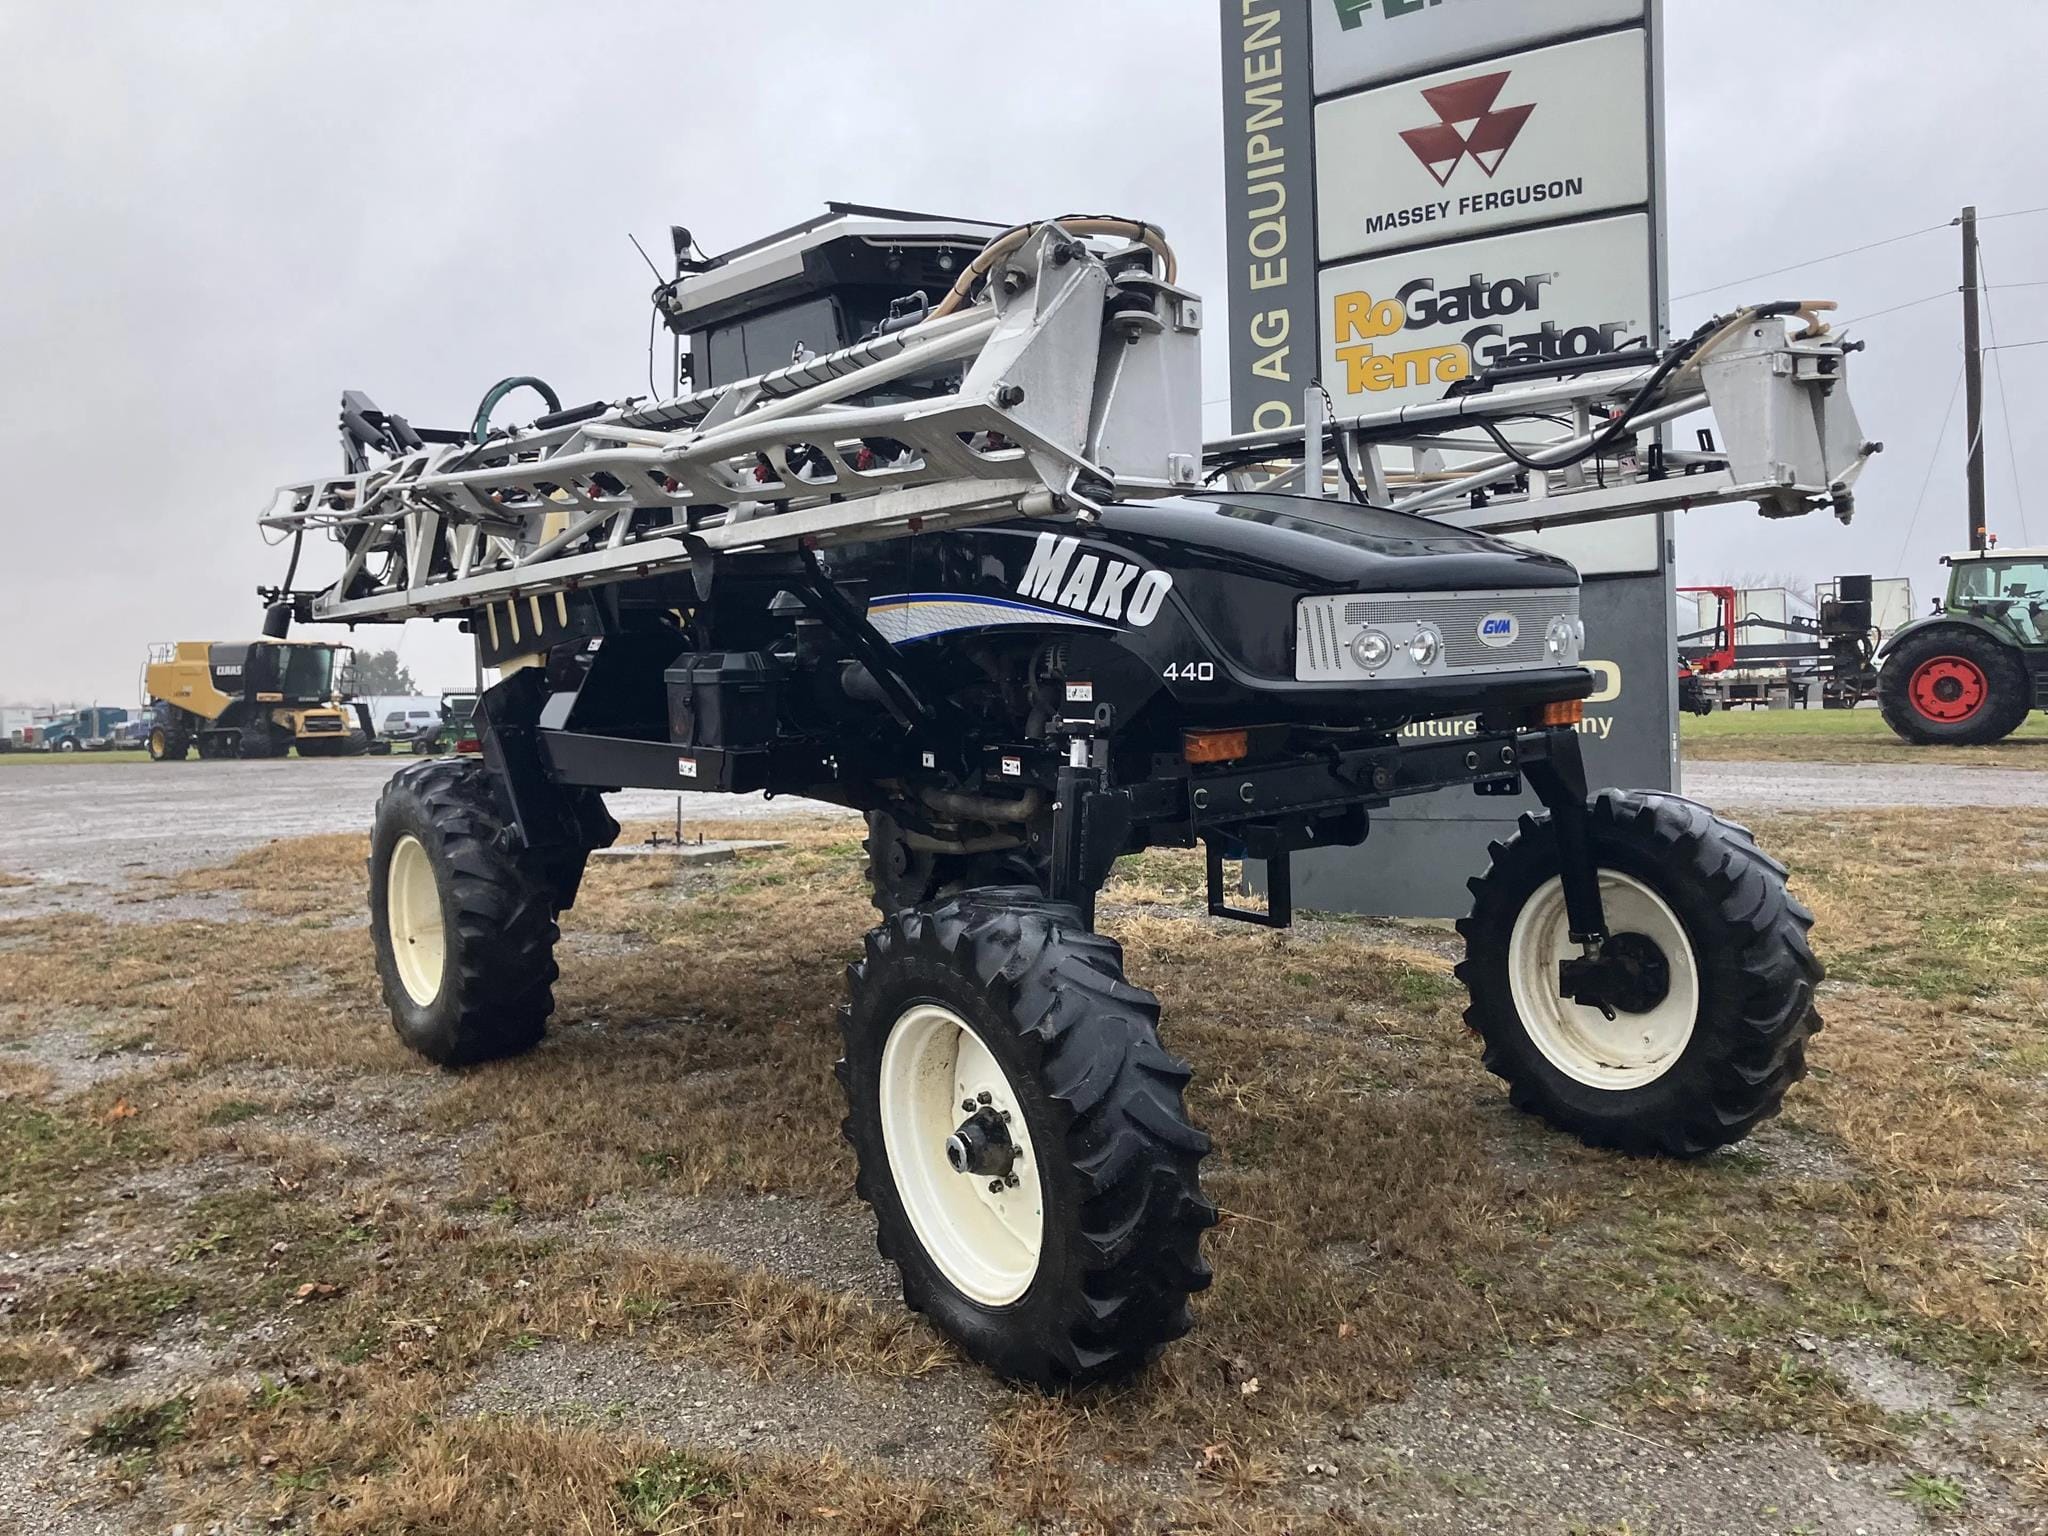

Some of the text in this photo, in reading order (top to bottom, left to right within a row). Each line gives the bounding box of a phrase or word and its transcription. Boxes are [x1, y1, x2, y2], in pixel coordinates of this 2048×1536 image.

[1365, 177, 1583, 234] MASSEY FERGUSON
[1250, 308, 1290, 382] AG
[1016, 531, 1173, 627] MAKO
[1482, 619, 1511, 635] GVM
[1163, 662, 1214, 681] 440
